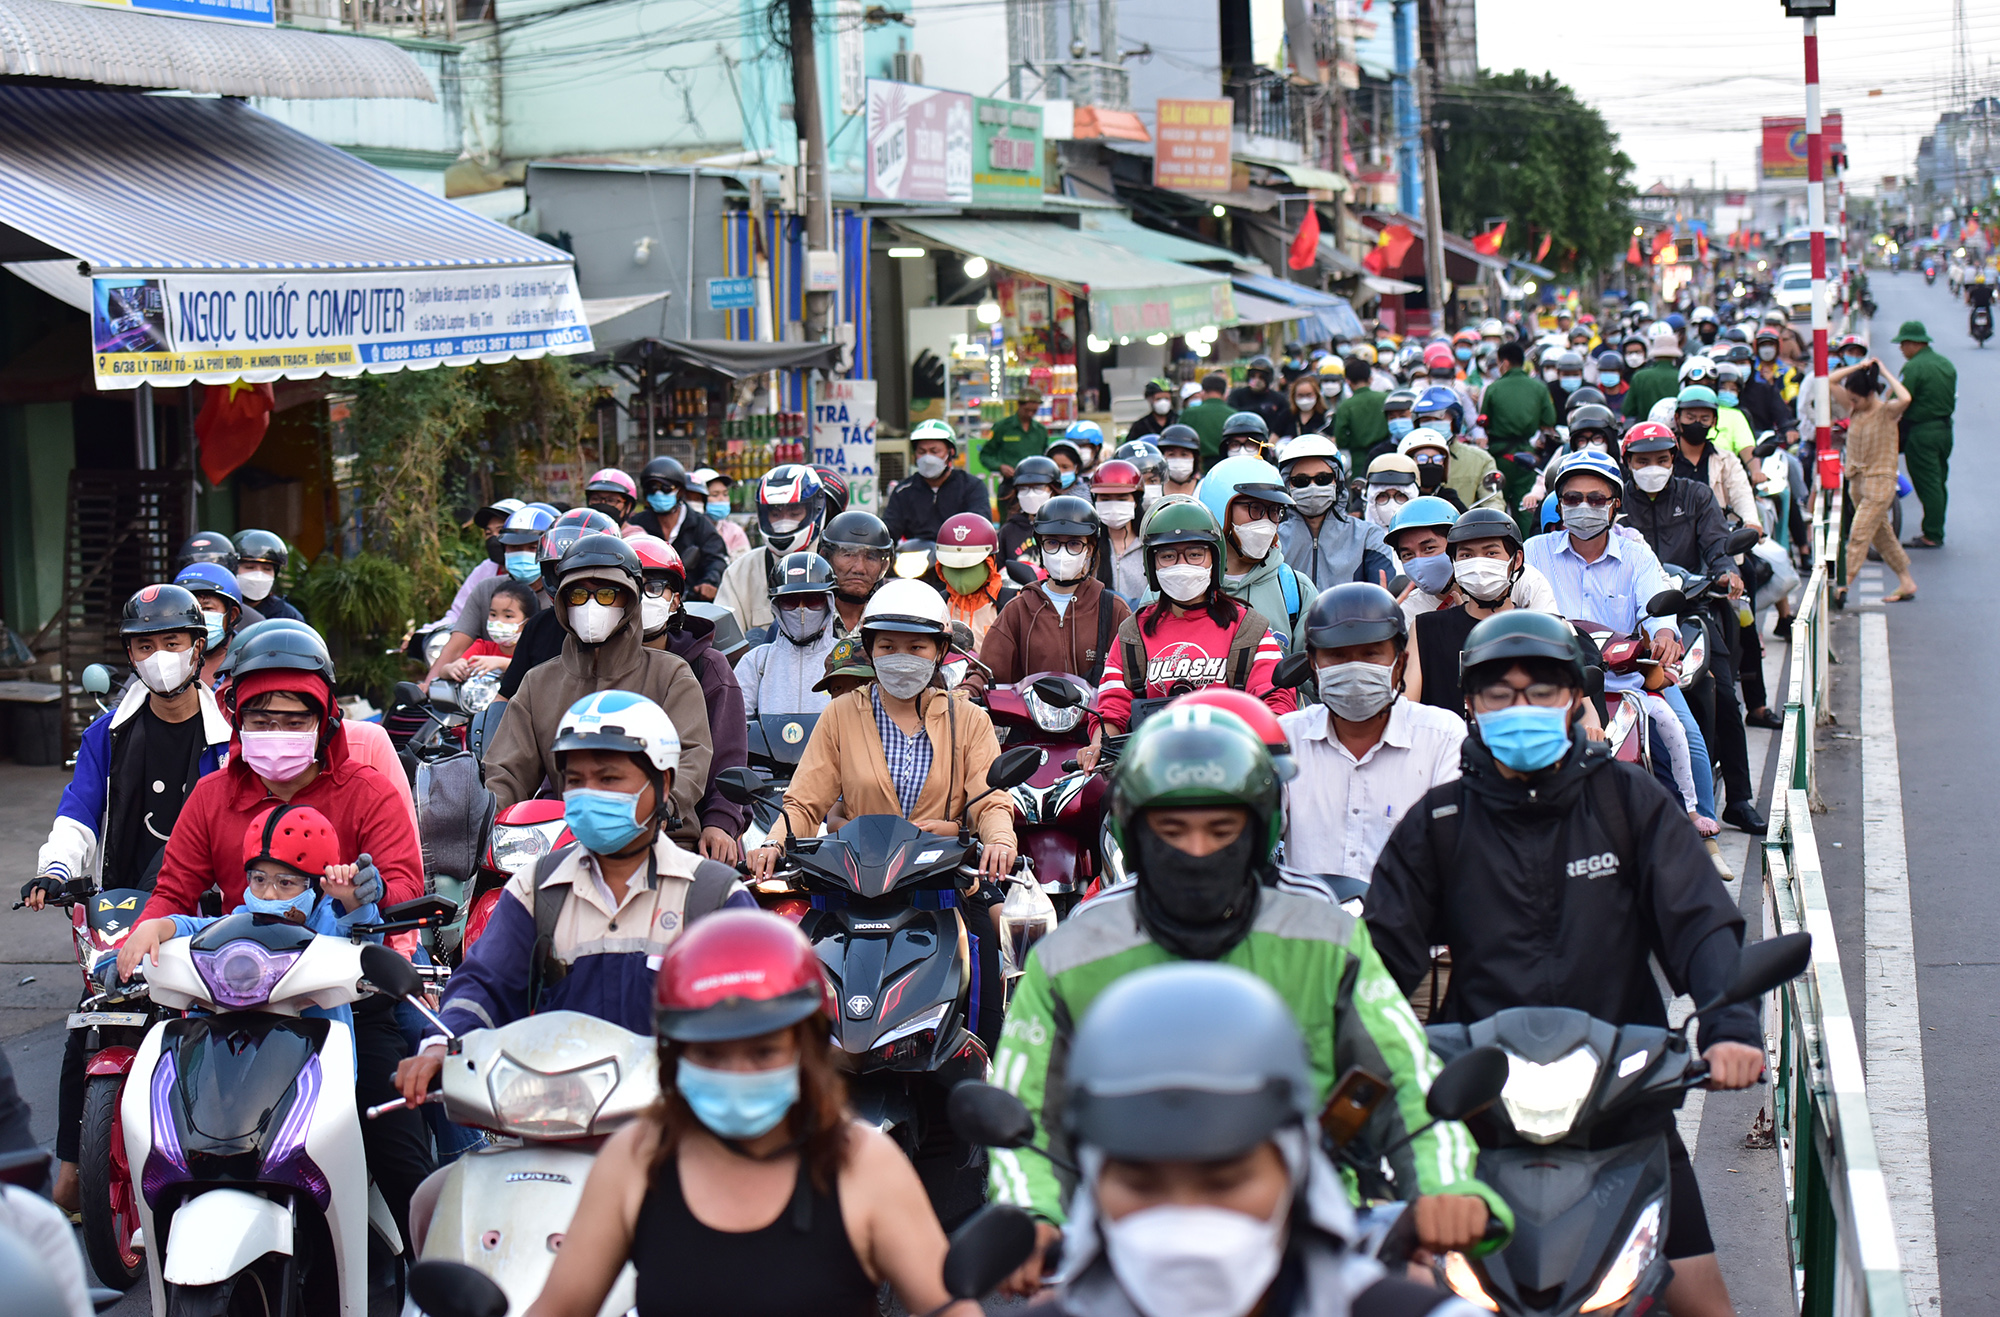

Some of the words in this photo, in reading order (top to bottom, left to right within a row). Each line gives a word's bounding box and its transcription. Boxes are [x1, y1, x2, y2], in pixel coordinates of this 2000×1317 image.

[179, 290, 237, 348] NGỌC
[245, 281, 300, 342] QUỐC
[307, 287, 405, 339] COMPUTER
[383, 344, 409, 361] 0888
[411, 342, 432, 359] 495
[434, 340, 453, 357] 490
[462, 338, 487, 354] 0933
[545, 327, 583, 348] QUỐC
[113, 360, 136, 374] 6/38
[138, 357, 150, 373] LÝ
[151, 357, 173, 373] THÁI
[193, 356, 206, 371] XÃ
[207, 355, 224, 371] PHÚ
[283, 353, 308, 370] TRẠCH
[315, 351, 337, 367] ĐỒNG
[338, 350, 352, 364] NAI
[815, 402, 850, 423] TRÀ
[841, 419, 875, 445] TẮC
[814, 445, 846, 466] TRÀ
[1147, 658, 1228, 685] ULASKI
[1165, 761, 1226, 786] Grab
[854, 922, 892, 930] HONDA
[505, 1172, 572, 1184] HONDA
